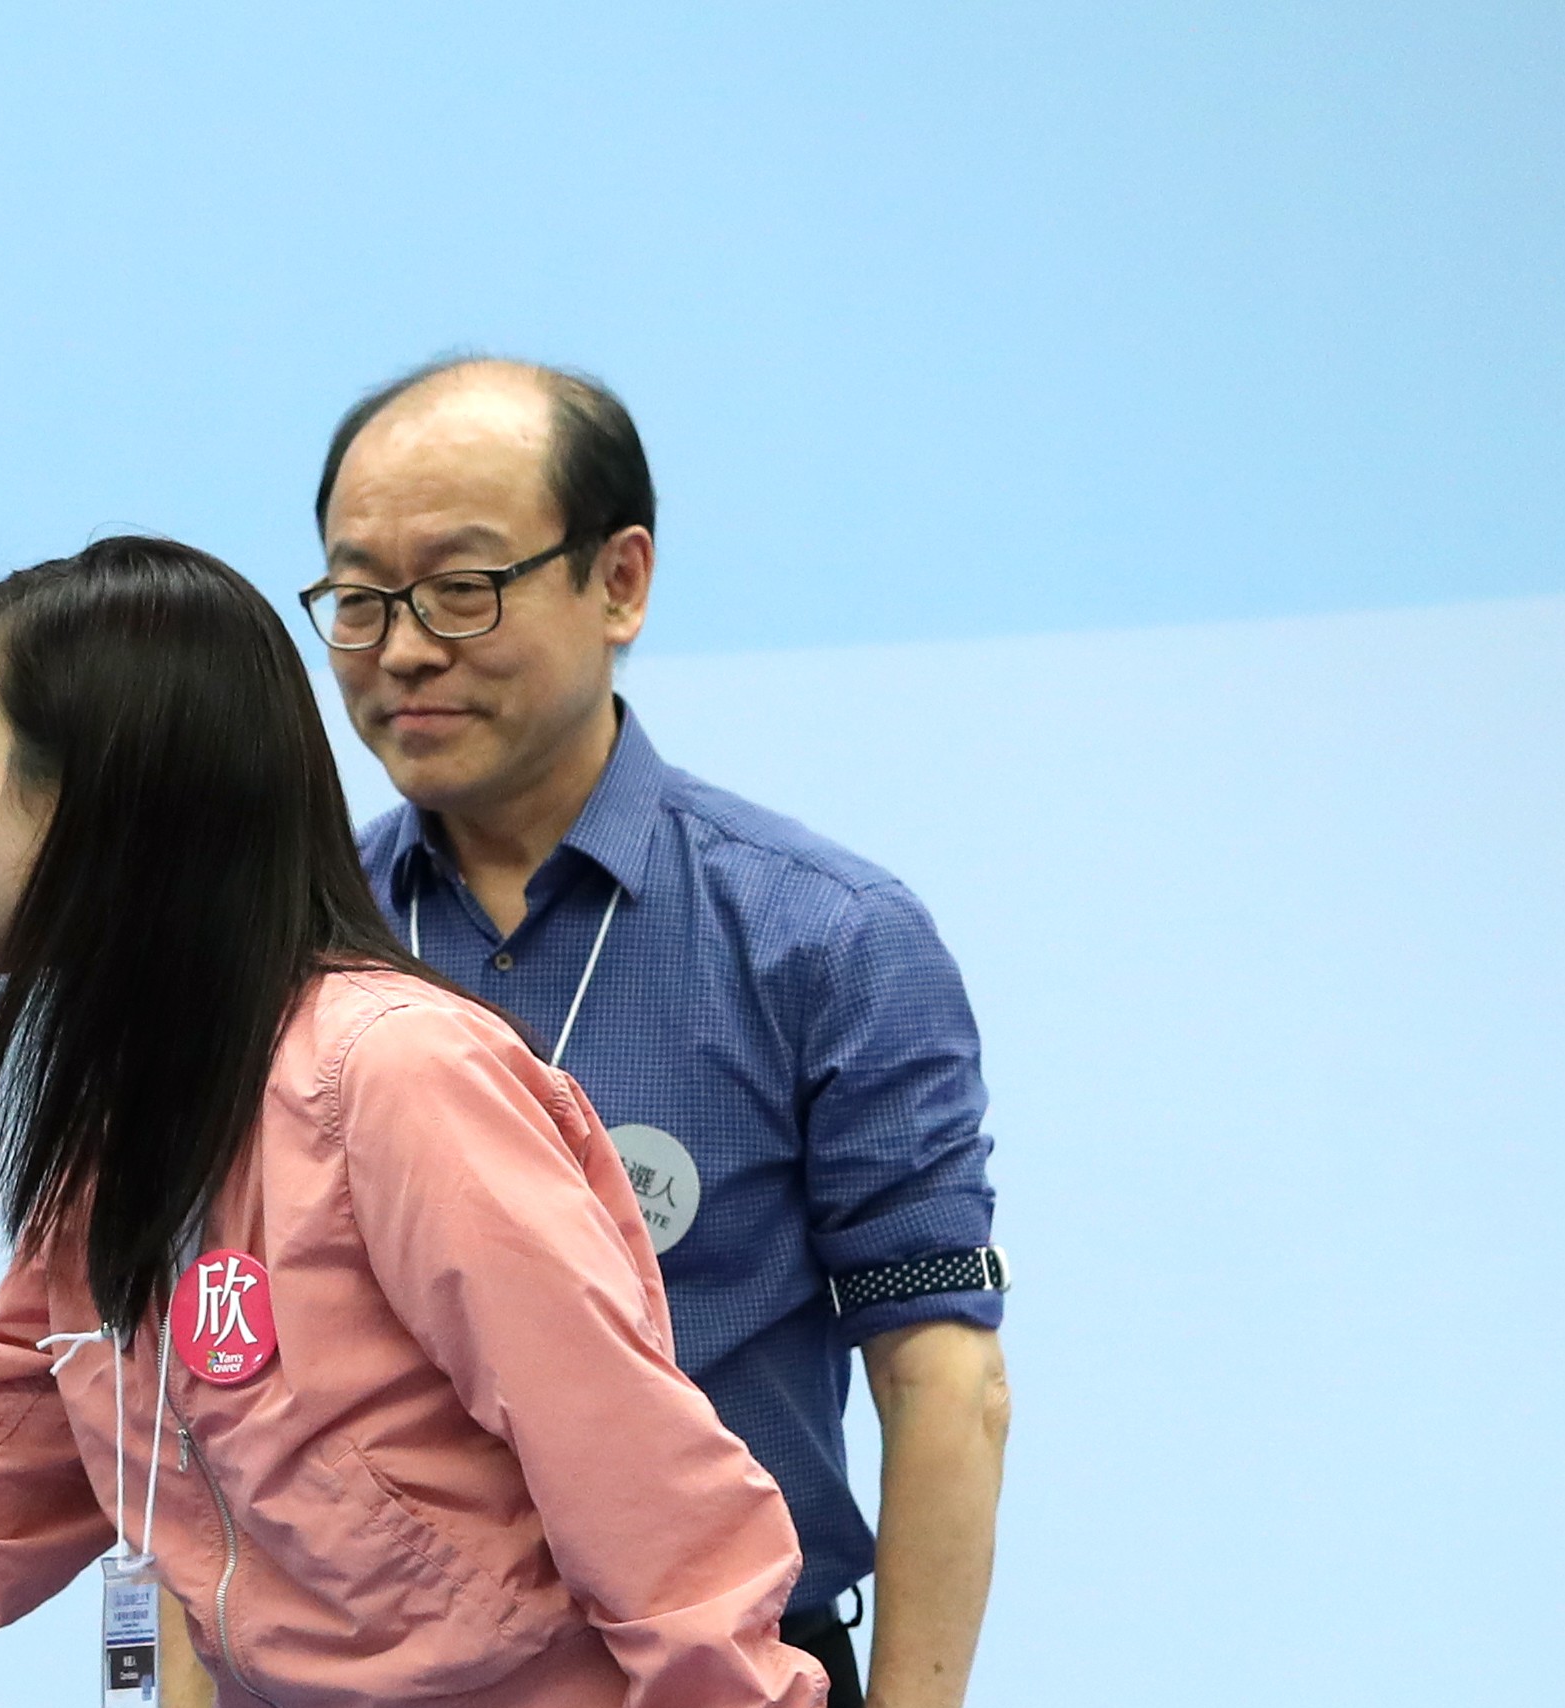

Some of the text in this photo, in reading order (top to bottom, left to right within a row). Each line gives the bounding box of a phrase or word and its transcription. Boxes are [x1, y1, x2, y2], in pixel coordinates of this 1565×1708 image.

[621, 1157, 677, 1208] 選人
[640, 1206, 671, 1230] ATE
[192, 1256, 258, 1347] 欣
